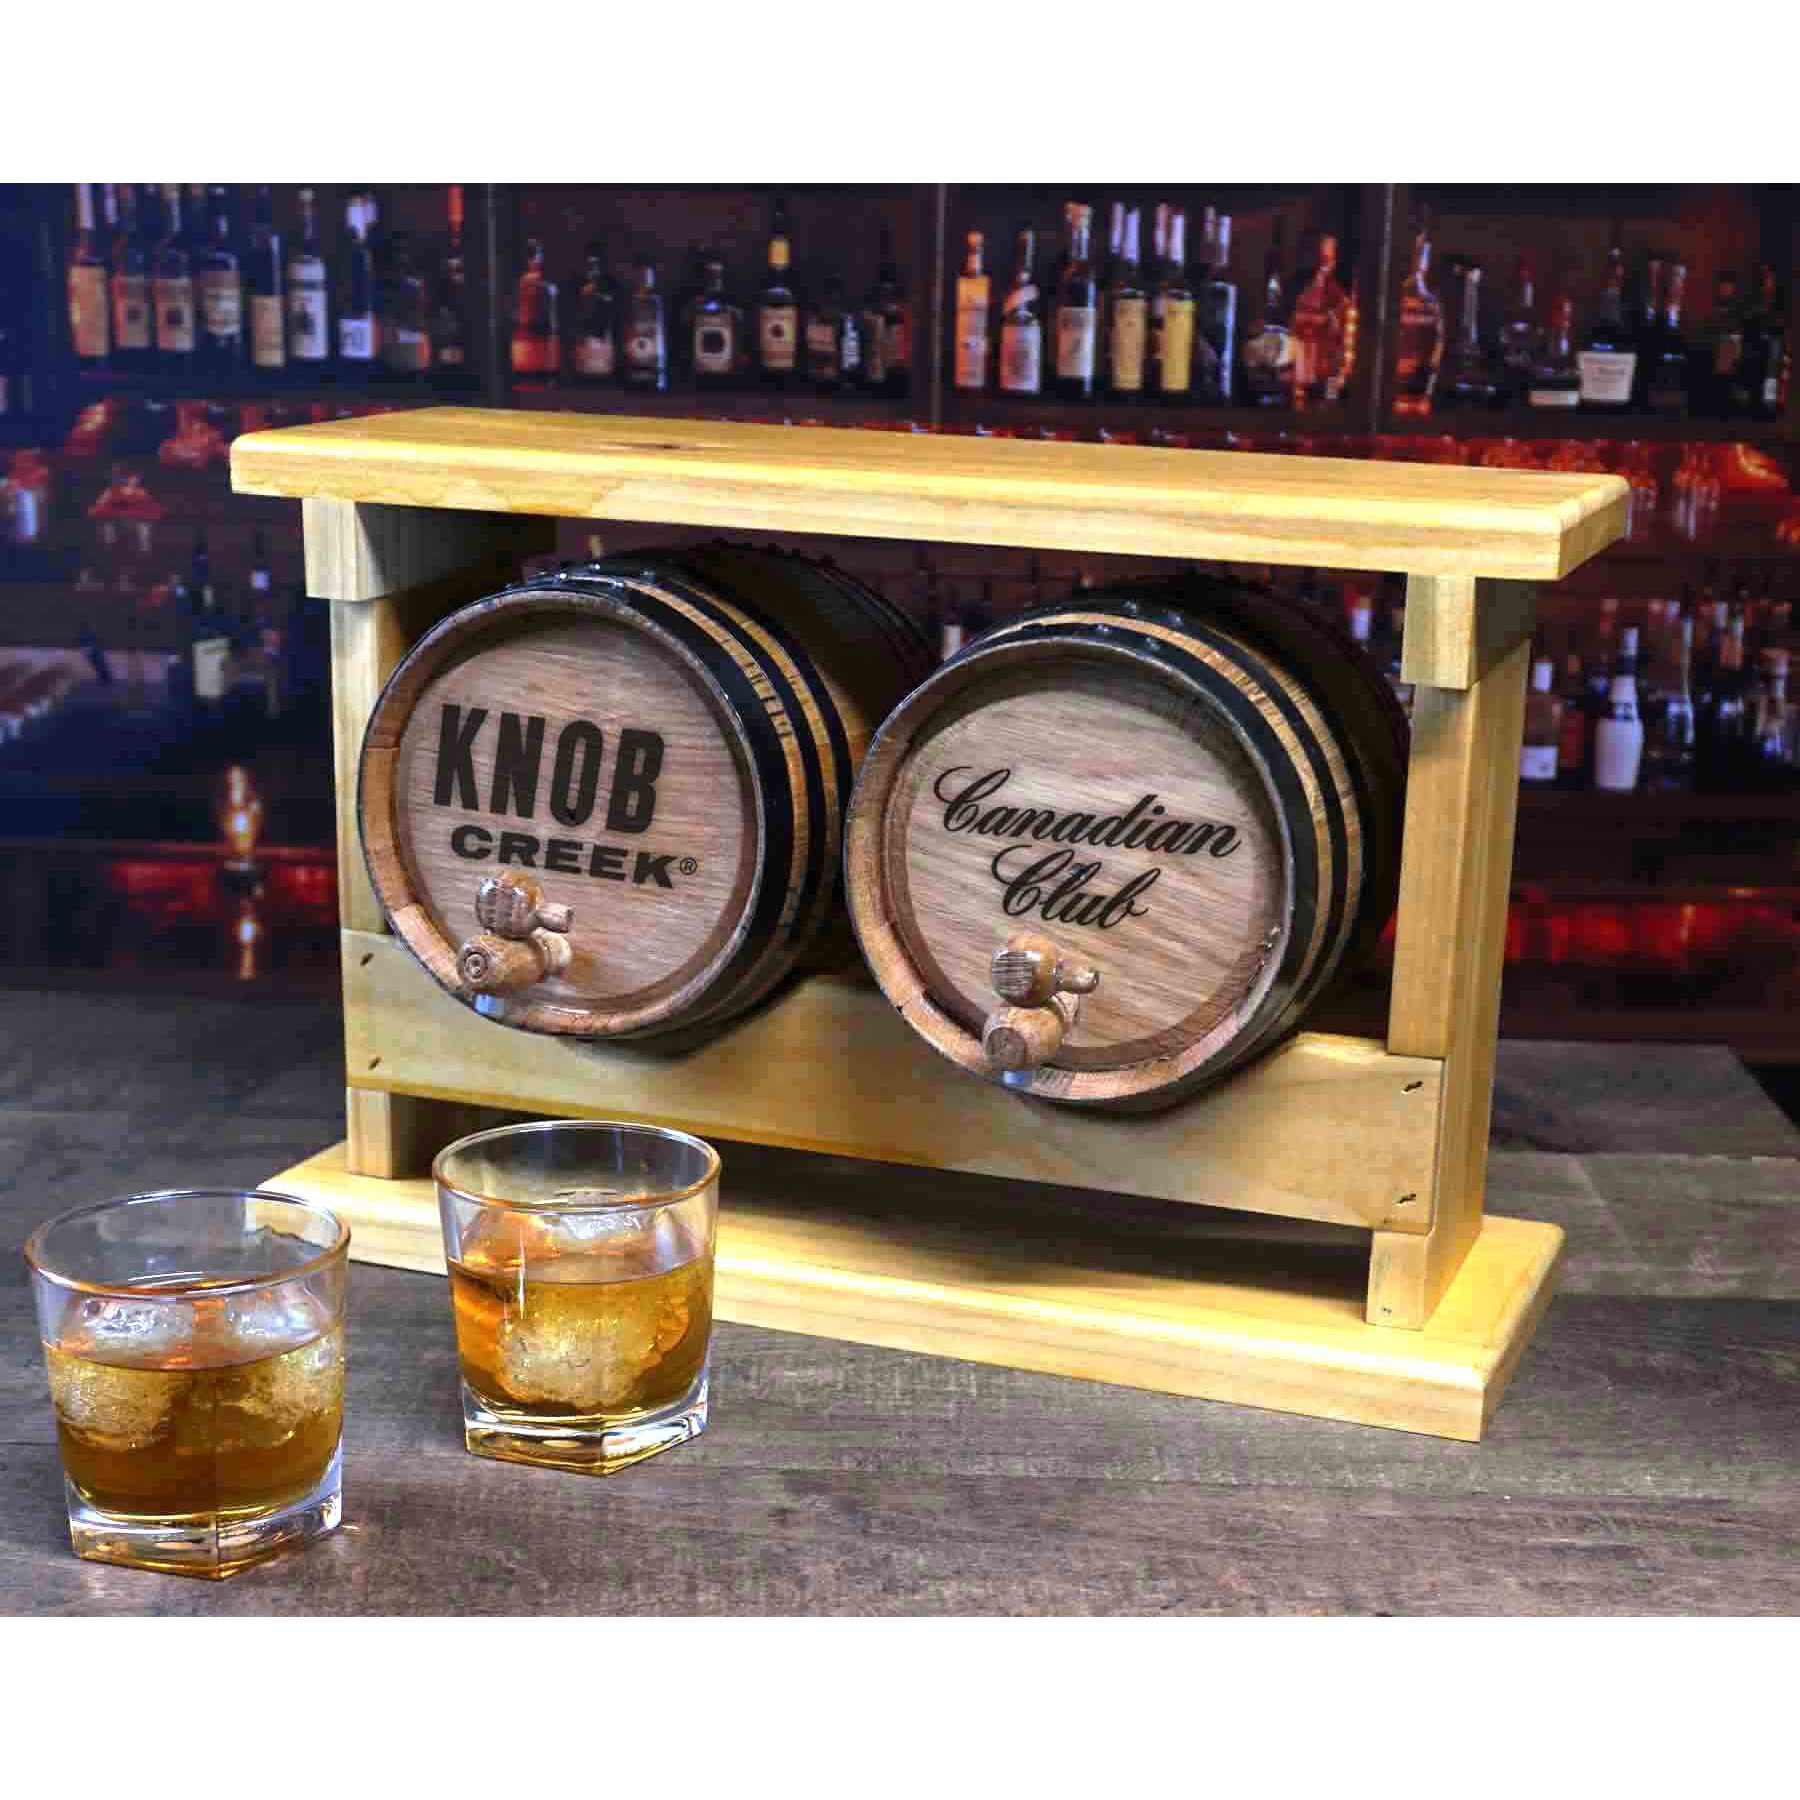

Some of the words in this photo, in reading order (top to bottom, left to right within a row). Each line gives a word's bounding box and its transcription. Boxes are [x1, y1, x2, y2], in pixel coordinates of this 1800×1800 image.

[433, 703, 665, 833] KNOB
[933, 766, 1242, 857] Canadian
[991, 845, 1161, 928] Club
